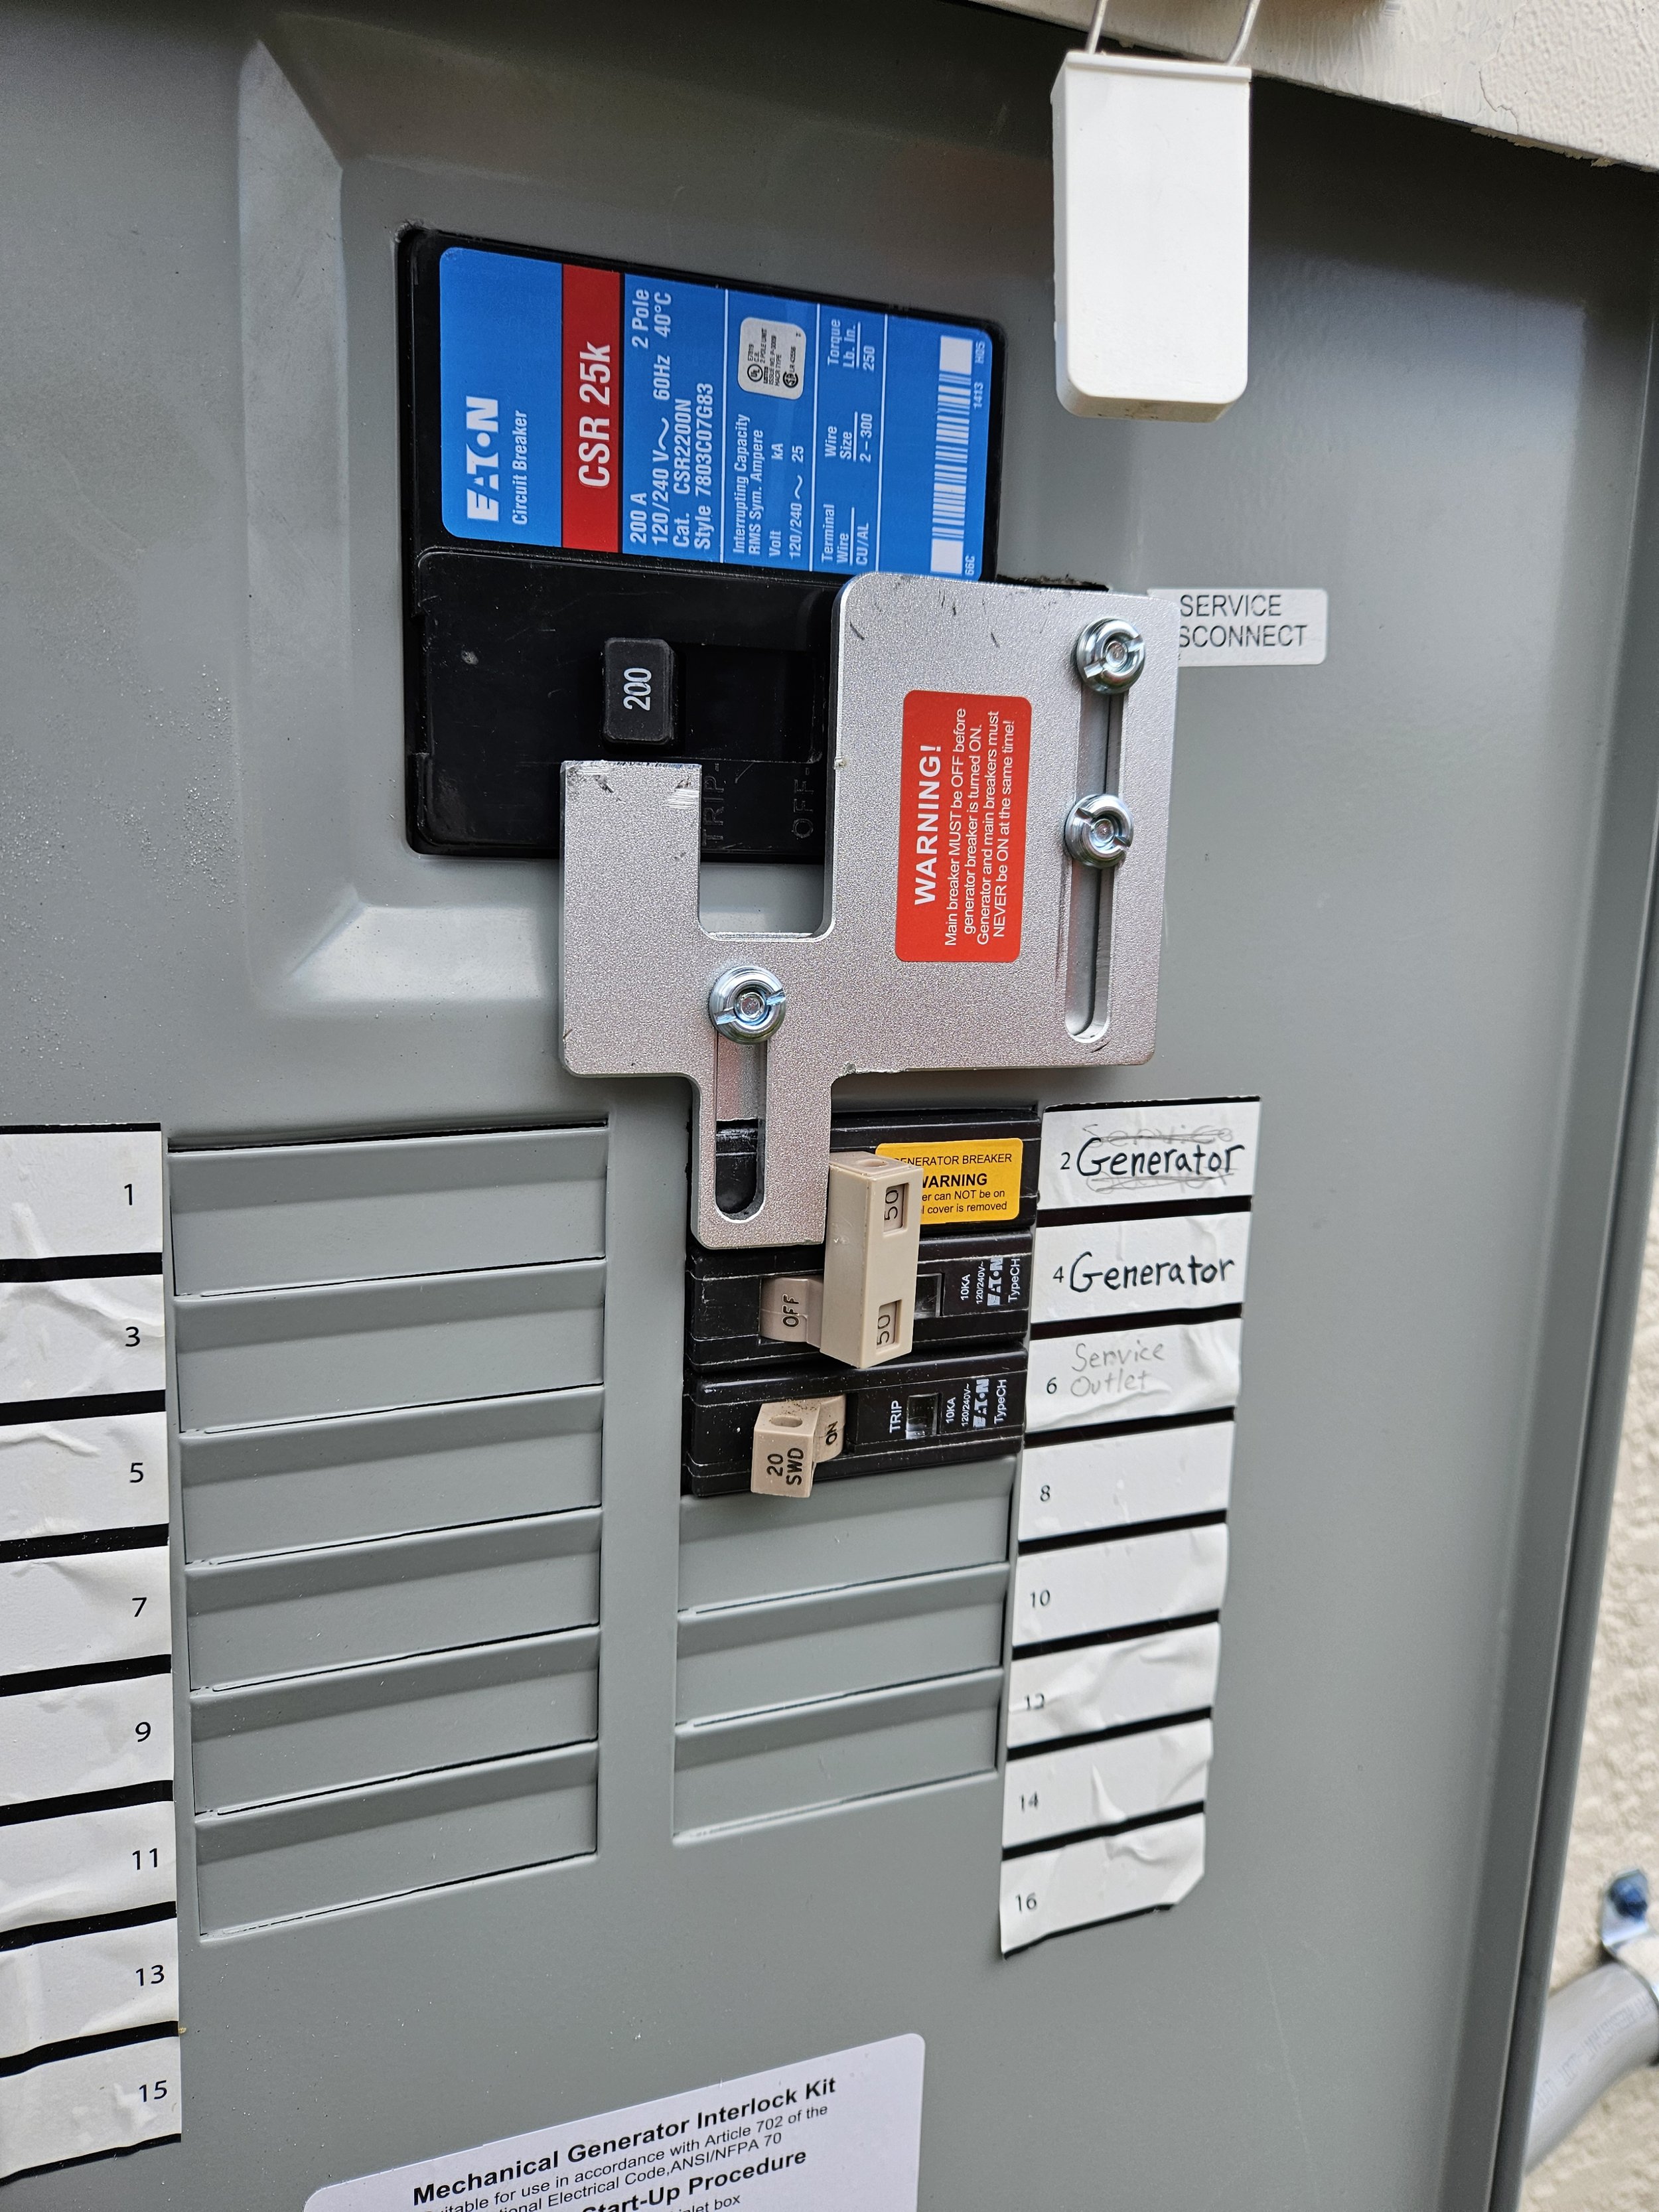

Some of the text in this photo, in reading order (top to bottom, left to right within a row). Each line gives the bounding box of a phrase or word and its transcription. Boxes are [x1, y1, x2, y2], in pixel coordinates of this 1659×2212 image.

[632, 289, 650, 349] 2 Pole
[654, 292, 672, 338] 40°C
[828, 319, 841, 366] Torque
[843, 325, 856, 369] Lb. In.
[863, 345, 875, 372] 250
[653, 354, 670, 401] 60Hz
[578, 341, 611, 487] CSR 25k
[771, 443, 783, 461] kA
[792, 445, 804, 463] 25
[825, 426, 837, 457] Wire
[839, 431, 852, 460] Size
[860, 413, 873, 463] 2 300
[466, 396, 498, 522] EATON
[512, 410, 528, 525] Circuit Breaker
[673, 399, 692, 548] Cat. CSR2200N
[694, 383, 715, 550] Style 7803C07G83
[733, 414, 751, 554] Interrupting Capacity
[749, 429, 764, 555] RMS Sym. Ampere
[630, 492, 647, 545] 200 A
[652, 468, 670, 546] 120/240
[769, 530, 782, 557] Volt
[822, 504, 835, 563] Terminal
[837, 533, 849, 563] Wire
[856, 523, 869, 565] CU/AL
[1180, 594, 1282, 617] SERVICE
[623, 668, 652, 711] 200
[703, 775, 725, 846] TRIP
[792, 779, 814, 839] OFF
[914, 745, 942, 905] WARNING!
[945, 708, 966, 946] Main breaker MUST be OFF before
[964, 724, 982, 934] generator breaker is turned ON.
[977, 711, 999, 945] Generator and main breakers must
[993, 721, 1014, 937] NEVER be ON at the same time!
[894, 1153, 1012, 1166] ENERATOR BREAKER
[1060, 1152, 1070, 1170] 2
[1076, 1137, 1245, 1177] Generator
[124, 1183, 133, 1206] 1
[884, 1189, 899, 1221] 50
[928, 1205, 954, 1214] cover
[956, 1203, 964, 1212] is
[967, 1201, 1007, 1211] removed
[954, 1189, 977, 1199] NOT
[960, 1274, 970, 1301] 10KA
[987, 1256, 1003, 1305] EATON
[1008, 1258, 1021, 1303] TypeCH
[1052, 1266, 1064, 1283] 4
[1070, 1251, 1235, 1293] Generator
[782, 1294, 800, 1327] OFF
[125, 1326, 141, 1347] 3
[877, 1314, 891, 1345] 50
[1071, 1339, 1165, 1372] Service
[1046, 1377, 1057, 1394] 6
[1070, 1367, 1151, 1397] Outlet
[889, 1400, 902, 1434] TRIP
[946, 1397, 956, 1424] 10KA
[973, 1378, 989, 1428] EATON
[994, 1379, 1007, 1424] TypeCH
[826, 1420, 838, 1445] ON
[129, 1462, 144, 1483] 5
[766, 1452, 784, 1477] 20
[786, 1447, 804, 1486] SWD
[1040, 1485, 1050, 1502] 8
[131, 1597, 147, 1617] 7
[1030, 1589, 1050, 1607] 10
[135, 1722, 151, 1743] 9
[1019, 1793, 1039, 1810] 14
[132, 1848, 158, 1870] 11
[1016, 1894, 1037, 1912] 16
[135, 1964, 165, 1986] 13
[139, 2080, 167, 2102] 15
[413, 2077, 836, 2206] Mechanical Generator Interlock Kit
[423, 2104, 828, 2212] itable for use in accordance with Article 702 of the
[549, 2176, 618, 2207] Electrical
[764, 2132, 782, 2147] 70
[689, 2150, 806, 2195] Procedure
[715, 2195, 741, 2211] box
